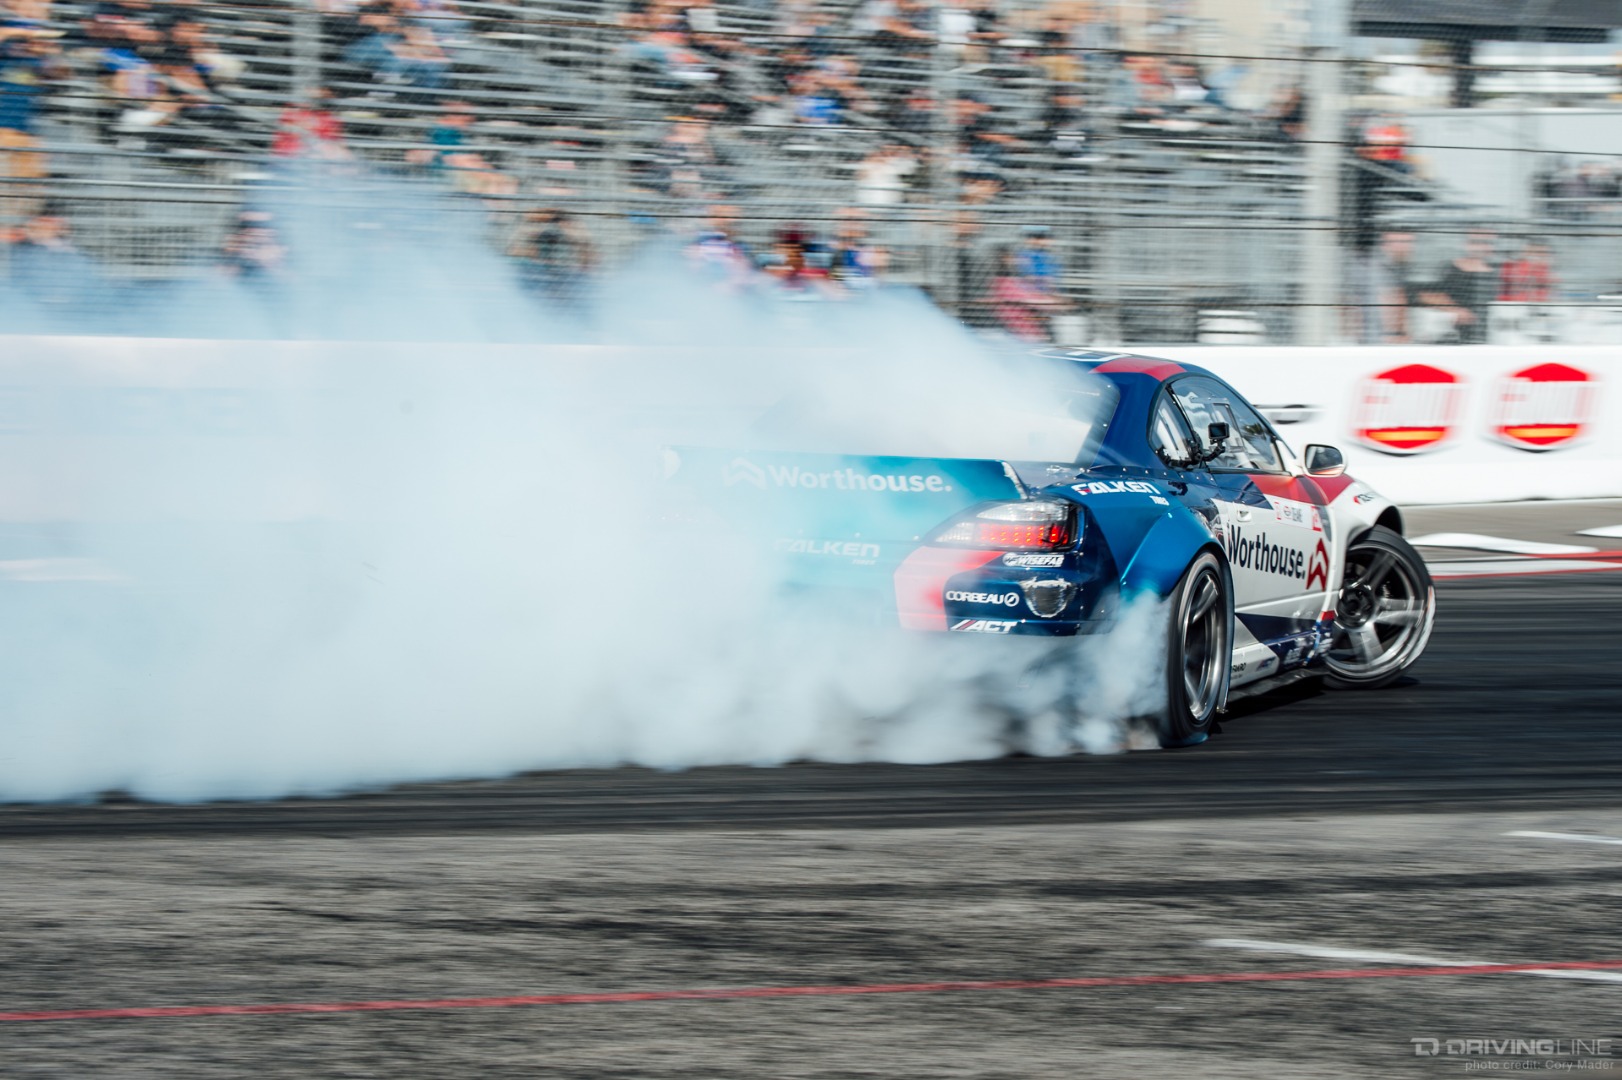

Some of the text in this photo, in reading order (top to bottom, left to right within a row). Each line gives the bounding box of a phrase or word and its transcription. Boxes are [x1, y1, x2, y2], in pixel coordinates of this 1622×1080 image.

[767, 464, 952, 492] Worthouse.
[1071, 480, 1161, 495] FALKEN
[773, 538, 880, 557] FALKEN
[1227, 523, 1306, 580] Worthouse.
[1015, 554, 1064, 568] WISEFAB
[946, 591, 1004, 605] CORBEAU
